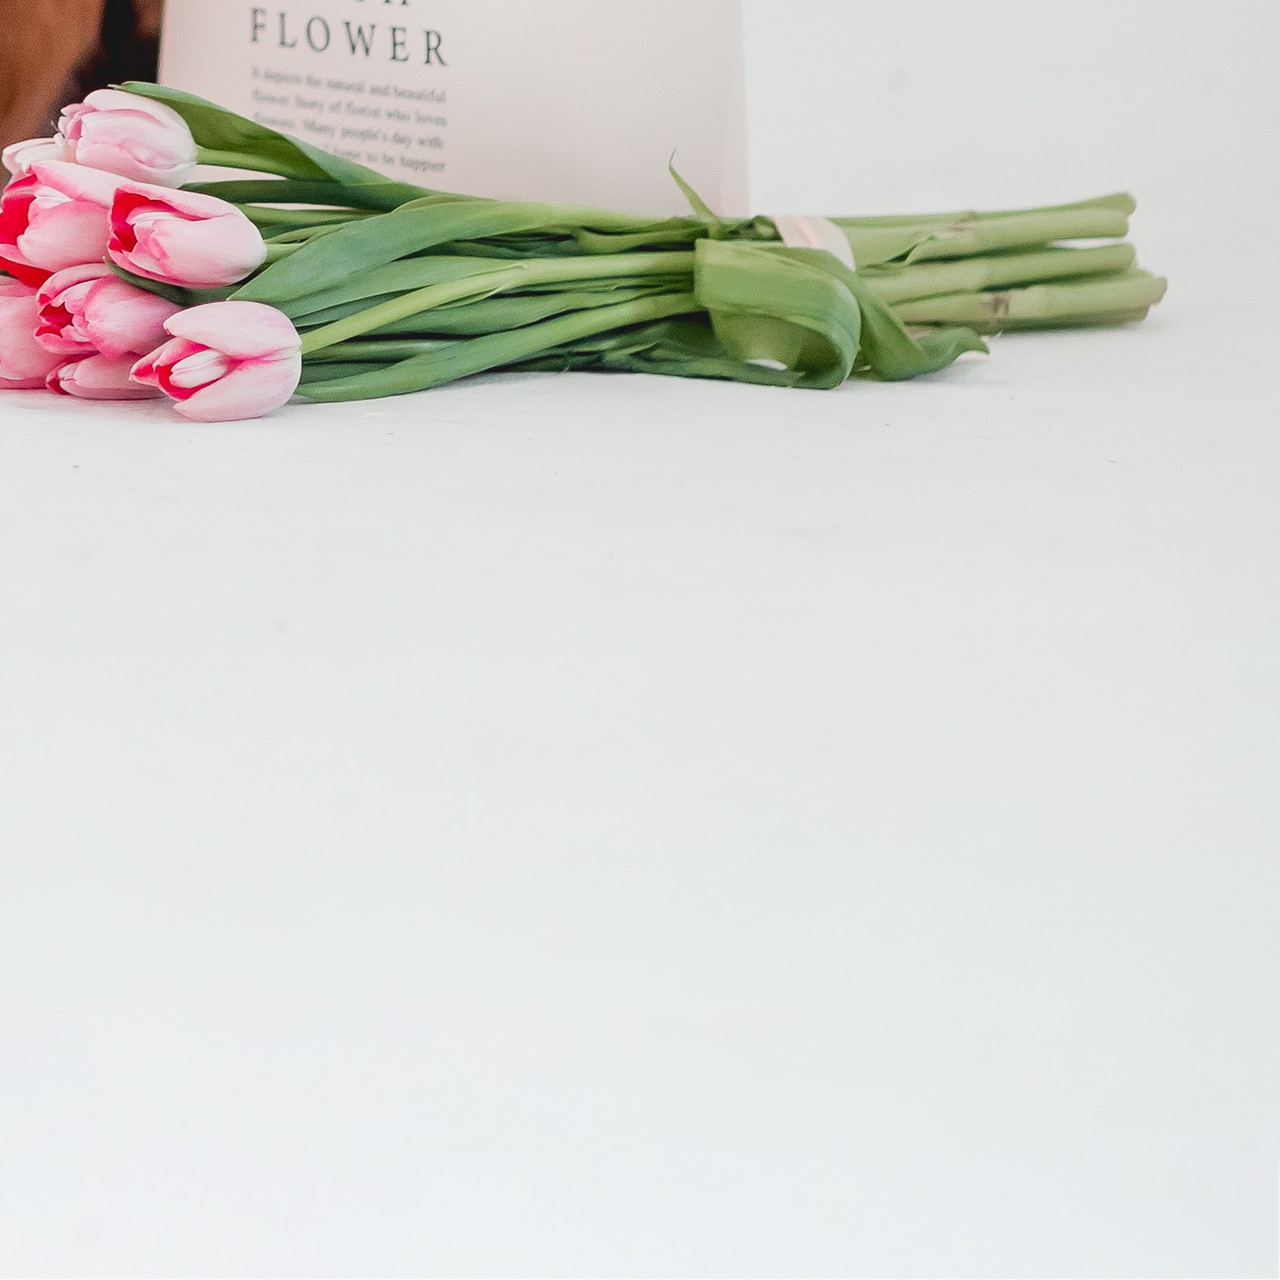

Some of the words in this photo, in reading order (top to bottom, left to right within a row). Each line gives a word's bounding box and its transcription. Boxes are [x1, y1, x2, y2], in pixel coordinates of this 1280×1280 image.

[251, 6, 450, 67] FLOWER
[306, 74, 321, 87] the
[326, 78, 365, 93] natural
[369, 83, 390, 96] and
[394, 85, 447, 103] beautiful
[330, 100, 342, 114] of
[386, 107, 412, 123] who
[415, 109, 447, 127] loves
[392, 129, 412, 149] day
[416, 134, 445, 150] with
[367, 150, 379, 164] to
[382, 151, 395, 166] be
[400, 154, 446, 174] happier
